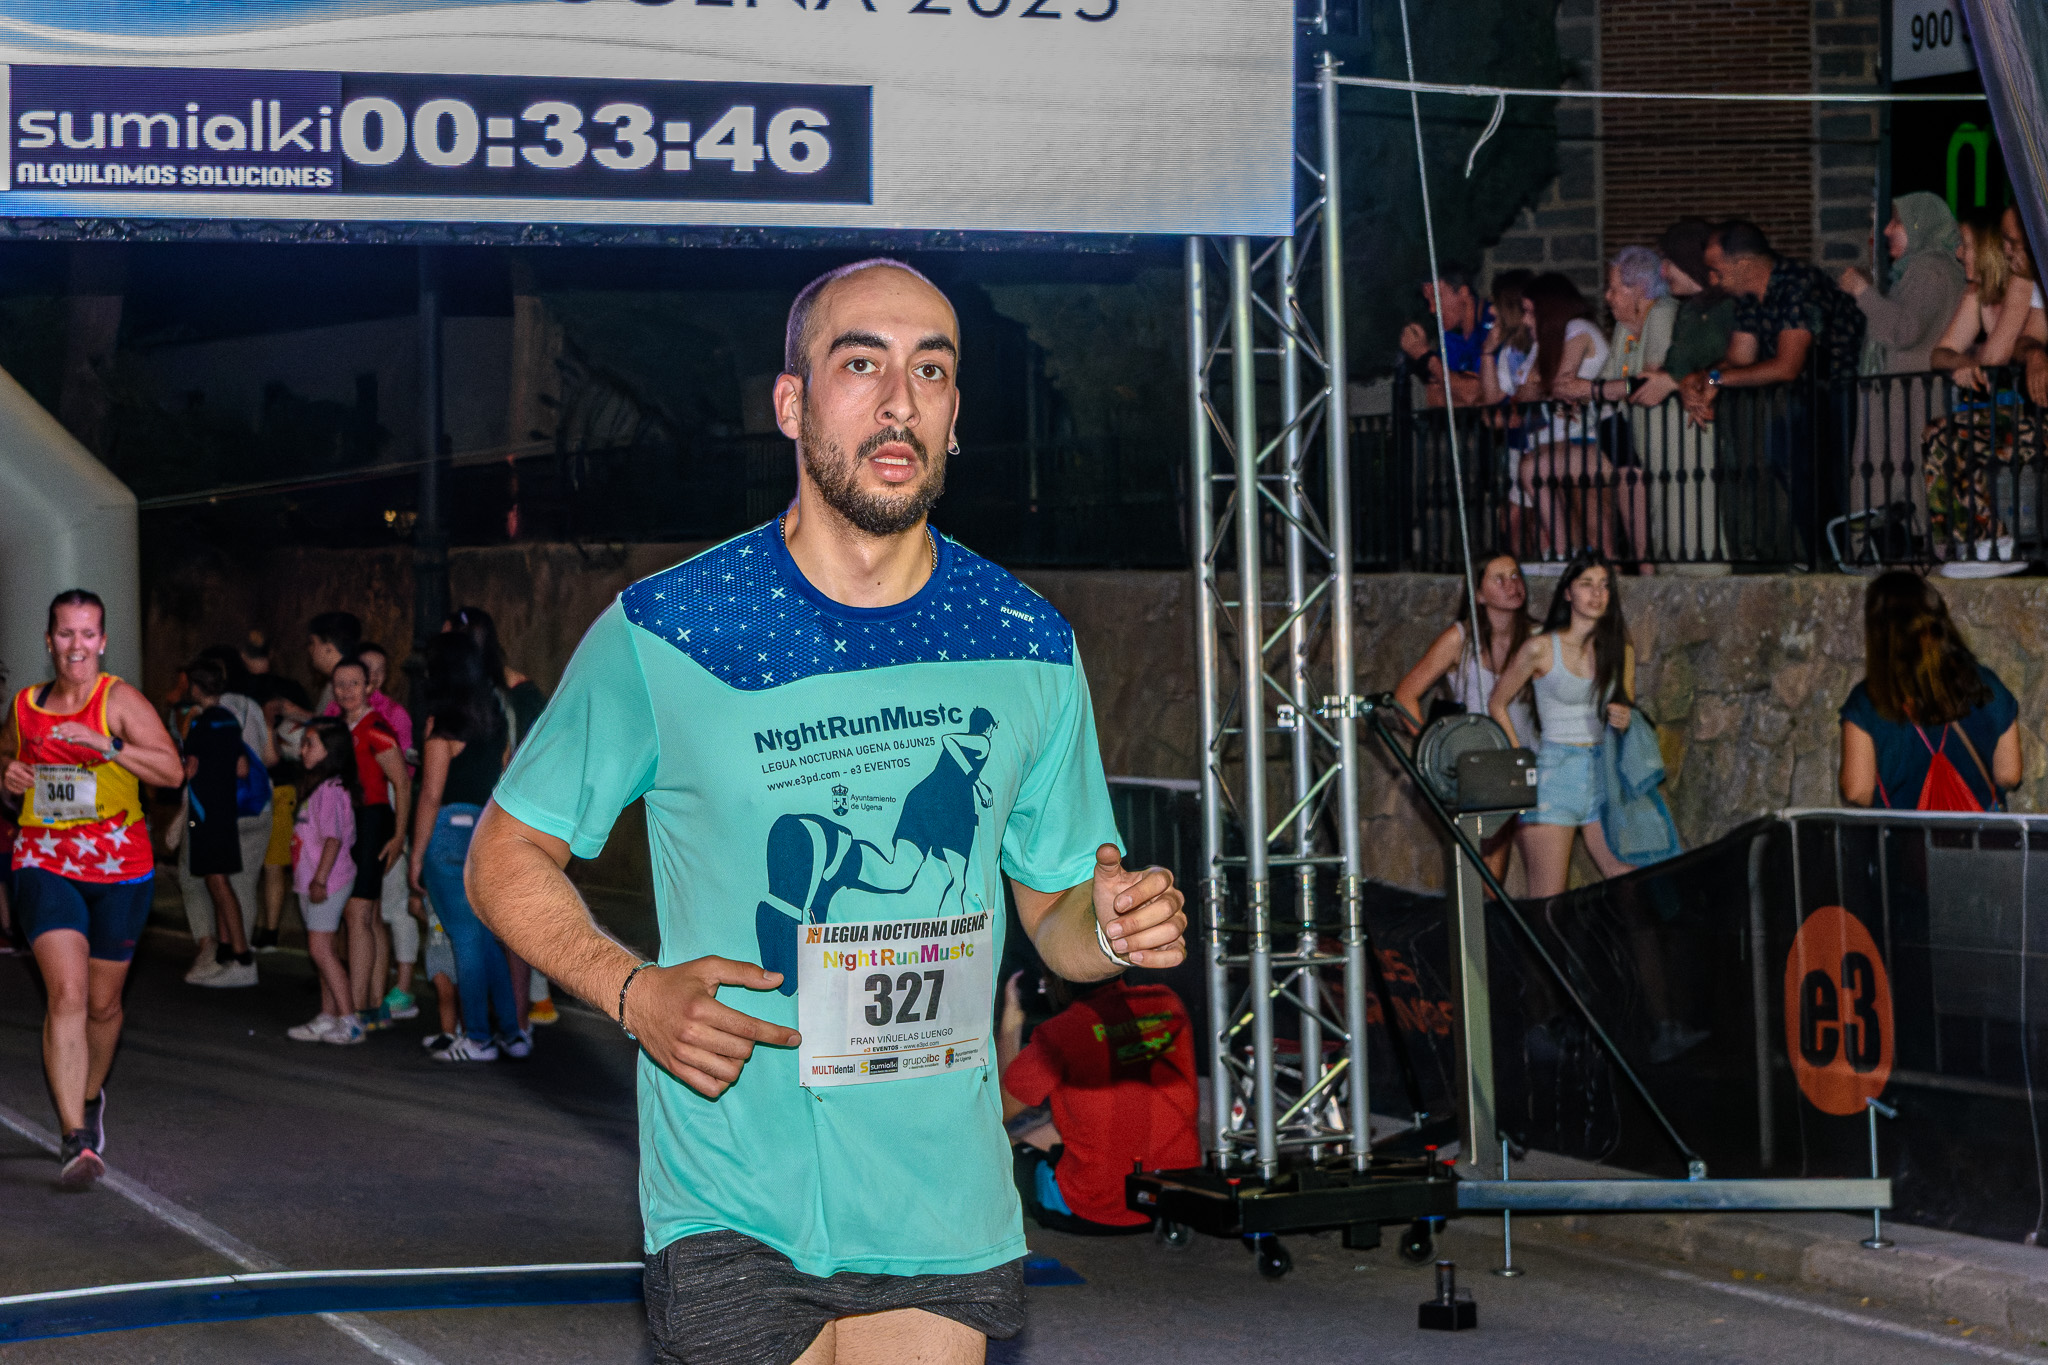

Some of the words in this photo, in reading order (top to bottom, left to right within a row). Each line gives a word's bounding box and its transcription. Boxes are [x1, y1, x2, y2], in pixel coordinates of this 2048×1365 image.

[1911, 9, 1953, 52] 900
[17, 99, 333, 152] sumialki
[340, 97, 832, 173] 00:33:46
[16, 163, 177, 186] ALQUILAMOS
[182, 165, 334, 187] SOLUCIONES
[761, 759, 797, 774] LEGUA
[799, 748, 854, 766] NOCTURNA
[855, 741, 891, 756] UGENA
[893, 736, 936, 750] 06JUN25
[767, 769, 841, 792] www.e3pd.com
[850, 764, 862, 775] e3
[864, 757, 911, 773] EVENTOS
[47, 782, 75, 801] 340
[850, 793, 897, 803] Ayuntamiento
[850, 802, 859, 810] de
[860, 803, 883, 812] Ugena
[823, 925, 869, 943] LEGUA
[872, 920, 948, 941] NOCTURNA
[950, 914, 985, 936] UGENA
[864, 969, 945, 1027] 327
[1800, 951, 1882, 1074] e3
[850, 1036, 875, 1046] FRAN
[876, 1032, 919, 1043] VIÑUELAS
[921, 1028, 953, 1039] LUENGO
[812, 1064, 856, 1076] MULTIdental
